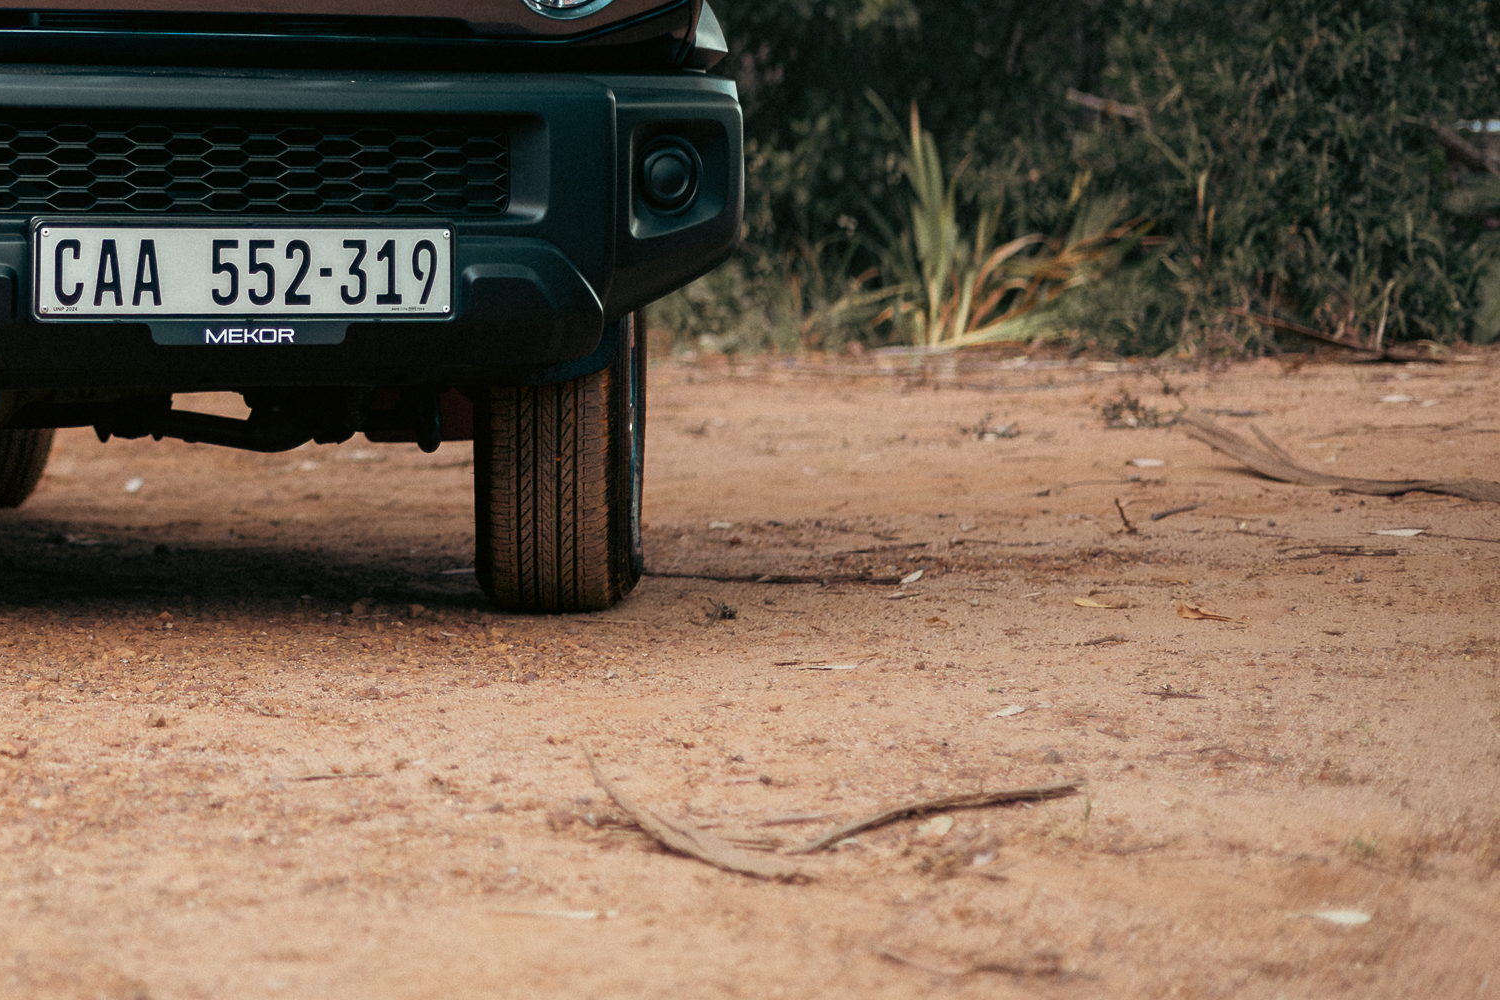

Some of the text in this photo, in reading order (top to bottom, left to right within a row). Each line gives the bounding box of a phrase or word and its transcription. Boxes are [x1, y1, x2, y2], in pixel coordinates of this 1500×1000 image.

[54, 238, 438, 306] CAA 552-319
[205, 328, 295, 344] MEKOR
